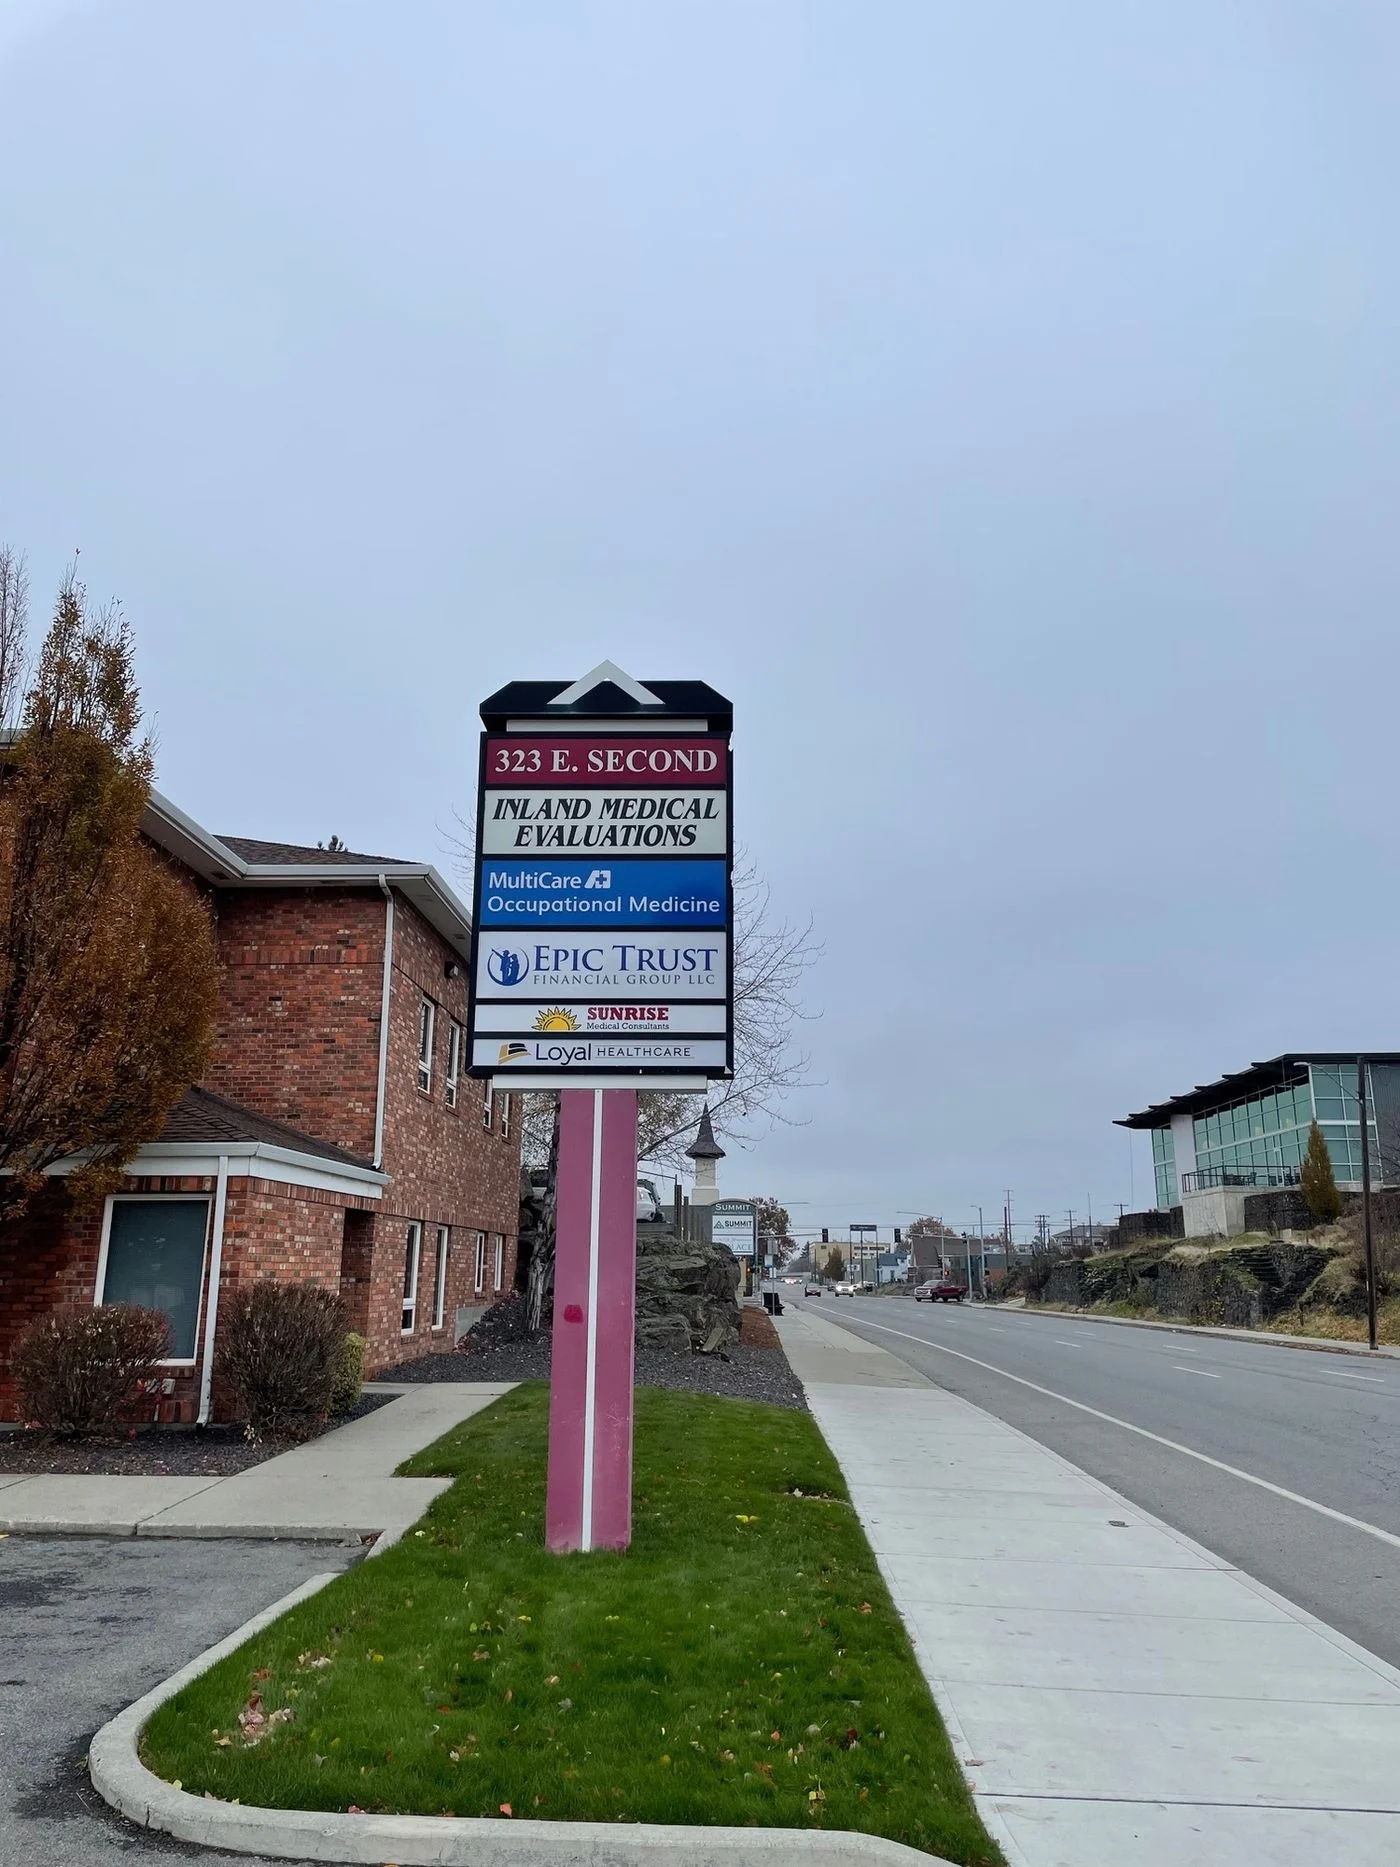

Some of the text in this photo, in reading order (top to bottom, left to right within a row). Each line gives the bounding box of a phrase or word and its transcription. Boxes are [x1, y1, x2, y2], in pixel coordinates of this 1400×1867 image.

[495, 749, 718, 773] 323 E. SECOND
[492, 798, 720, 820] INLAND MEDICAL
[514, 824, 697, 847] EVALUATIONS
[489, 871, 582, 889] MultiCare
[487, 895, 720, 916] Occupational Medicine
[534, 945, 719, 972] EPIC TRUST
[533, 974, 716, 985] FINANCIAL GROUP LLC
[587, 1007, 669, 1021] SUNRISE
[586, 1022, 670, 1030] Medical Consultants
[536, 1043, 691, 1066] Loyal HEALTHCARE
[715, 1203, 751, 1211] SUMMIT
